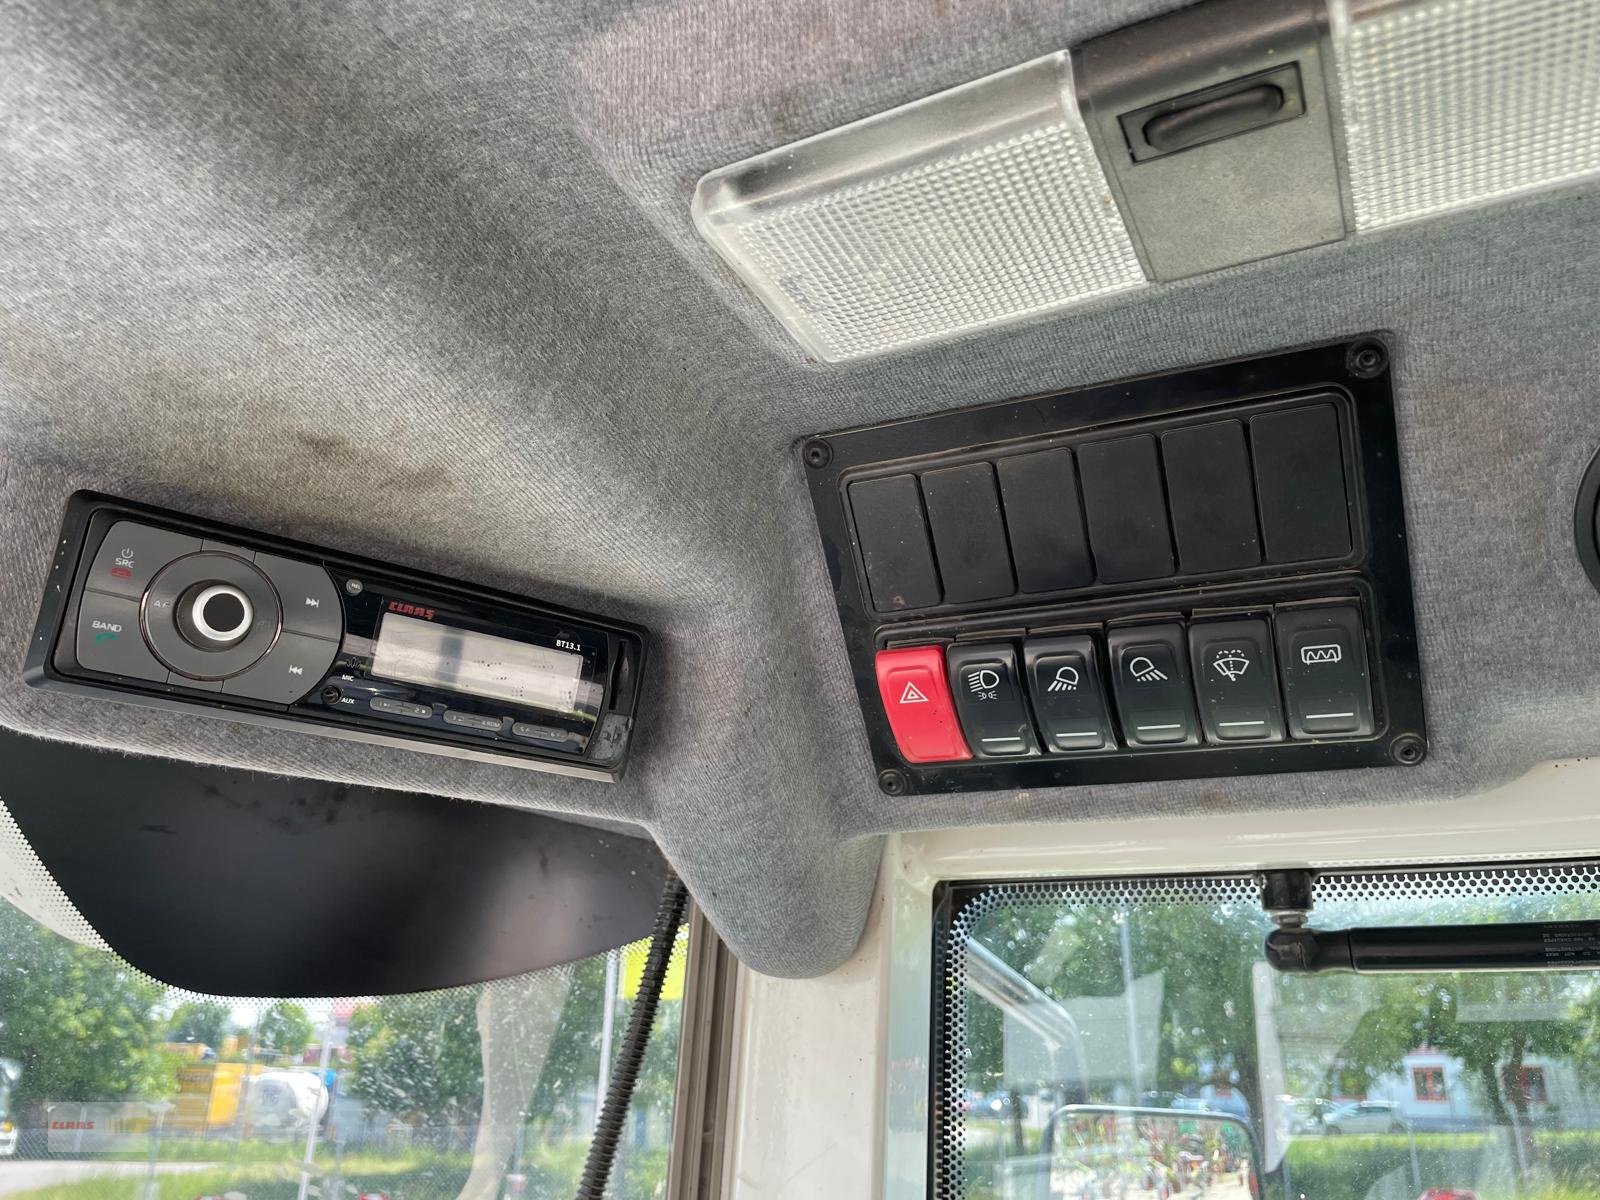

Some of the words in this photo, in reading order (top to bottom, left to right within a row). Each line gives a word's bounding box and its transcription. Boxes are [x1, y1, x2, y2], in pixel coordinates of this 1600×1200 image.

[115, 557, 135, 568] SRC
[388, 601, 436, 620] CLAAS
[92, 620, 122, 632] BAND
[556, 639, 581, 652] BT13.1
[341, 674, 355, 682] MIC
[341, 697, 355, 705] AUX
